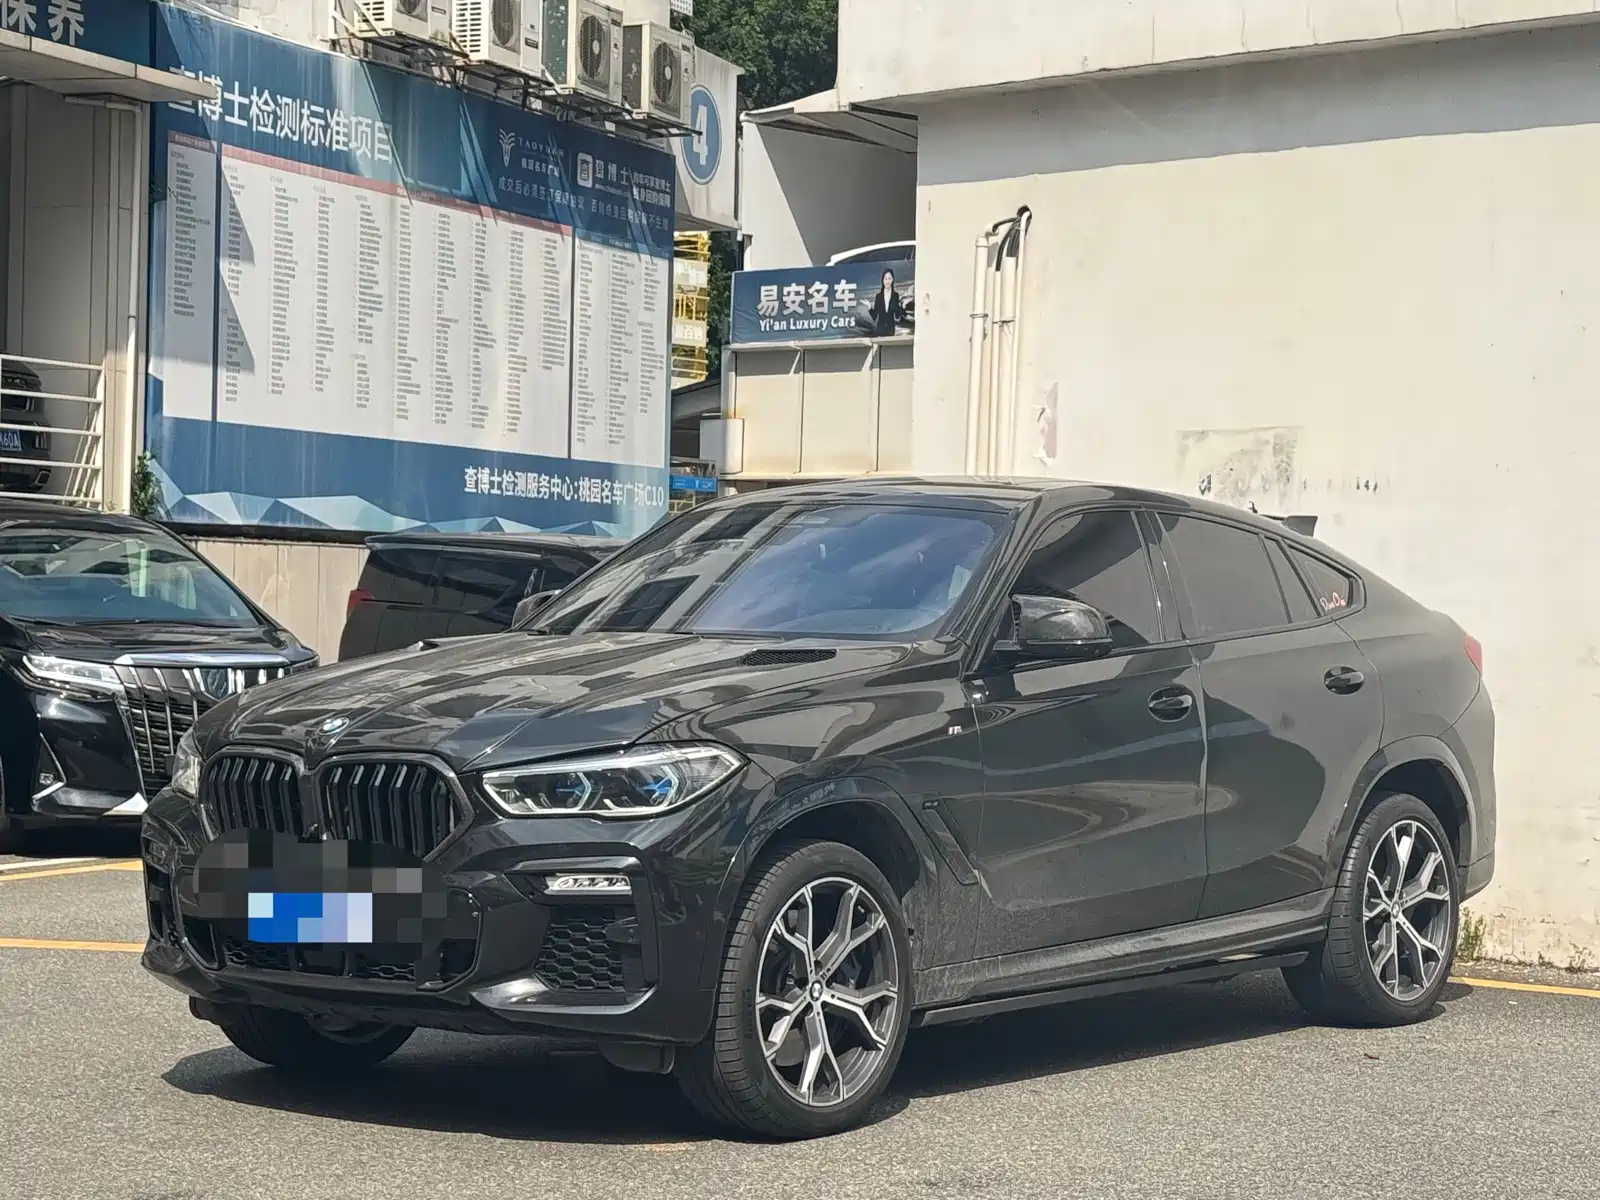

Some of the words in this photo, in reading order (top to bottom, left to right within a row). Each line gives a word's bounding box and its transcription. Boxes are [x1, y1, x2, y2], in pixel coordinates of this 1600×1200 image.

[693, 105, 708, 165] 4
[757, 279, 857, 317] 易安名车
[760, 318, 787, 332] Yi'an
[790, 317, 828, 332] Luxury
[831, 315, 856, 329] Cars
